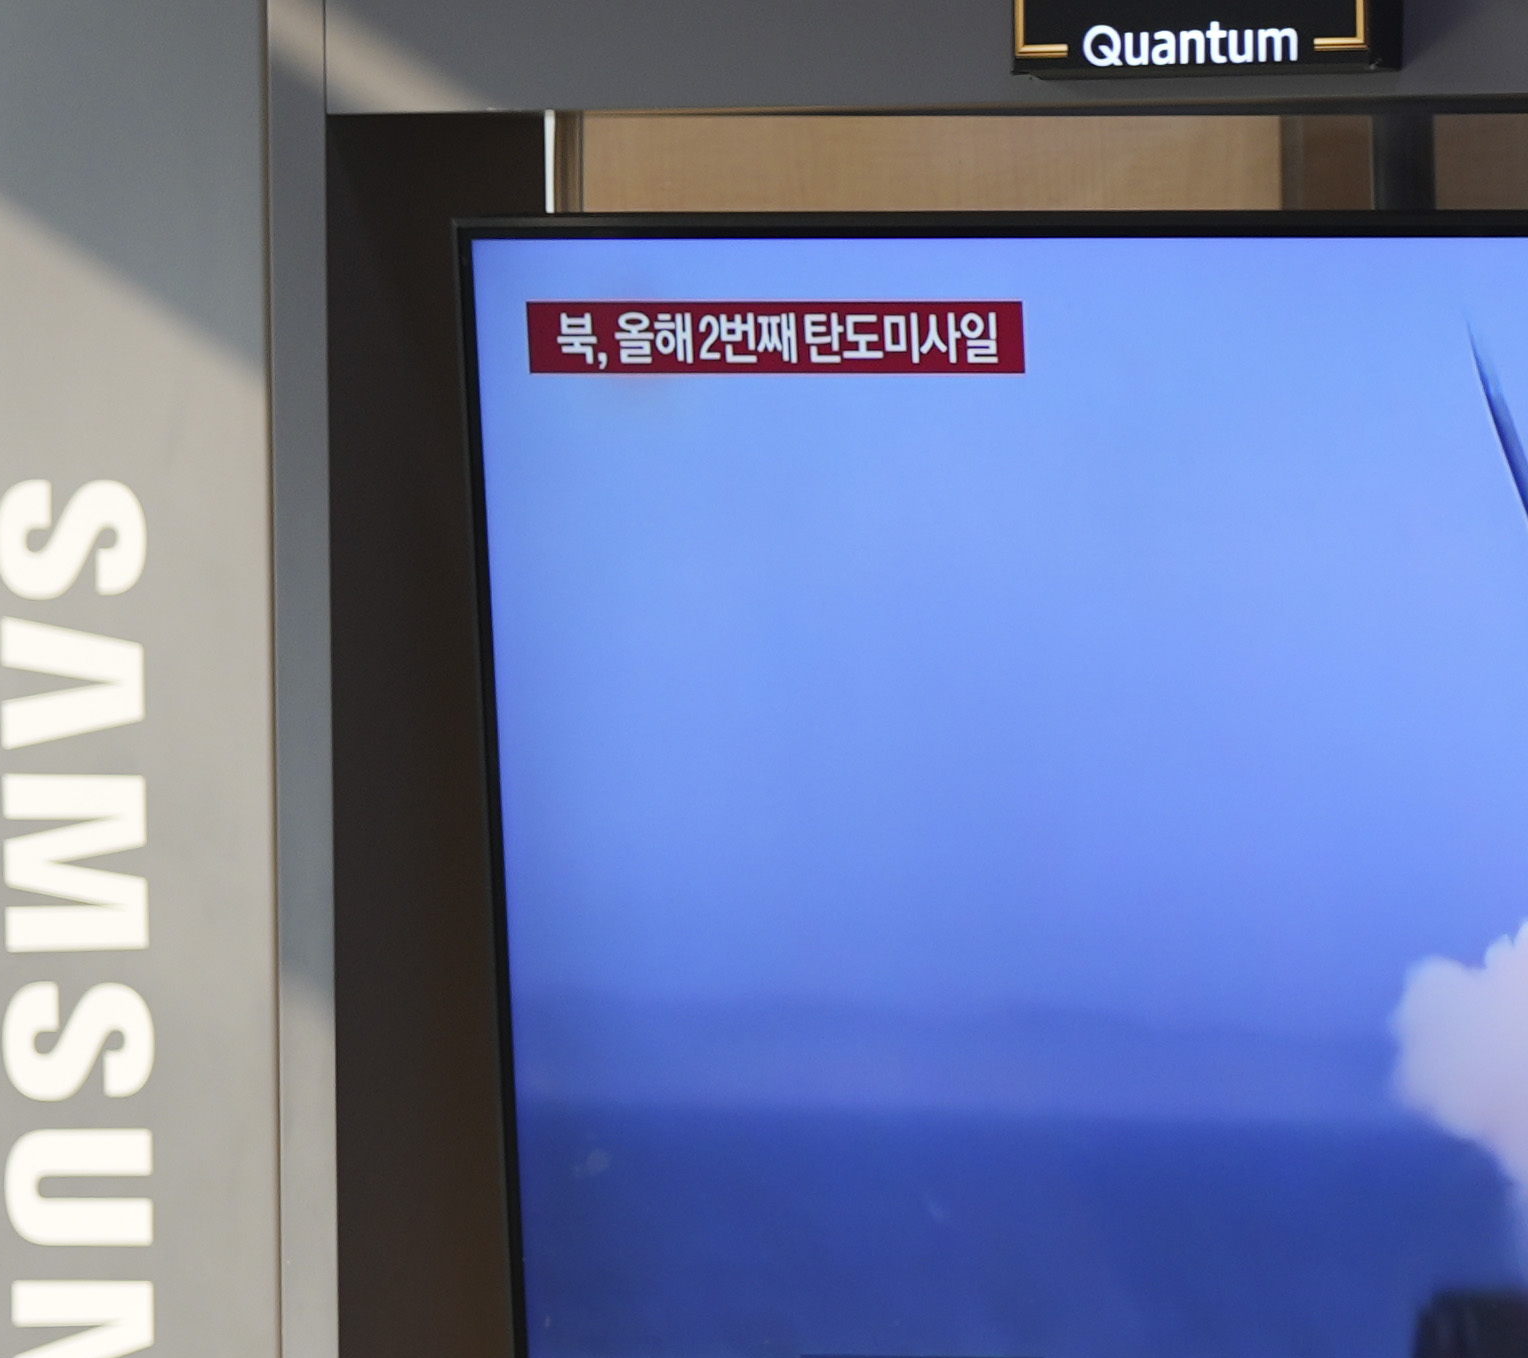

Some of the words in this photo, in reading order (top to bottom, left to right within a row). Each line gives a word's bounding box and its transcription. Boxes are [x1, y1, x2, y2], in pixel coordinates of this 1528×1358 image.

[1083, 21, 1298, 67] Quantum
[556, 312, 608, 370] 북,
[614, 311, 694, 364] 올해
[698, 312, 798, 364] 2번째
[803, 311, 999, 364] 탄도미사일
